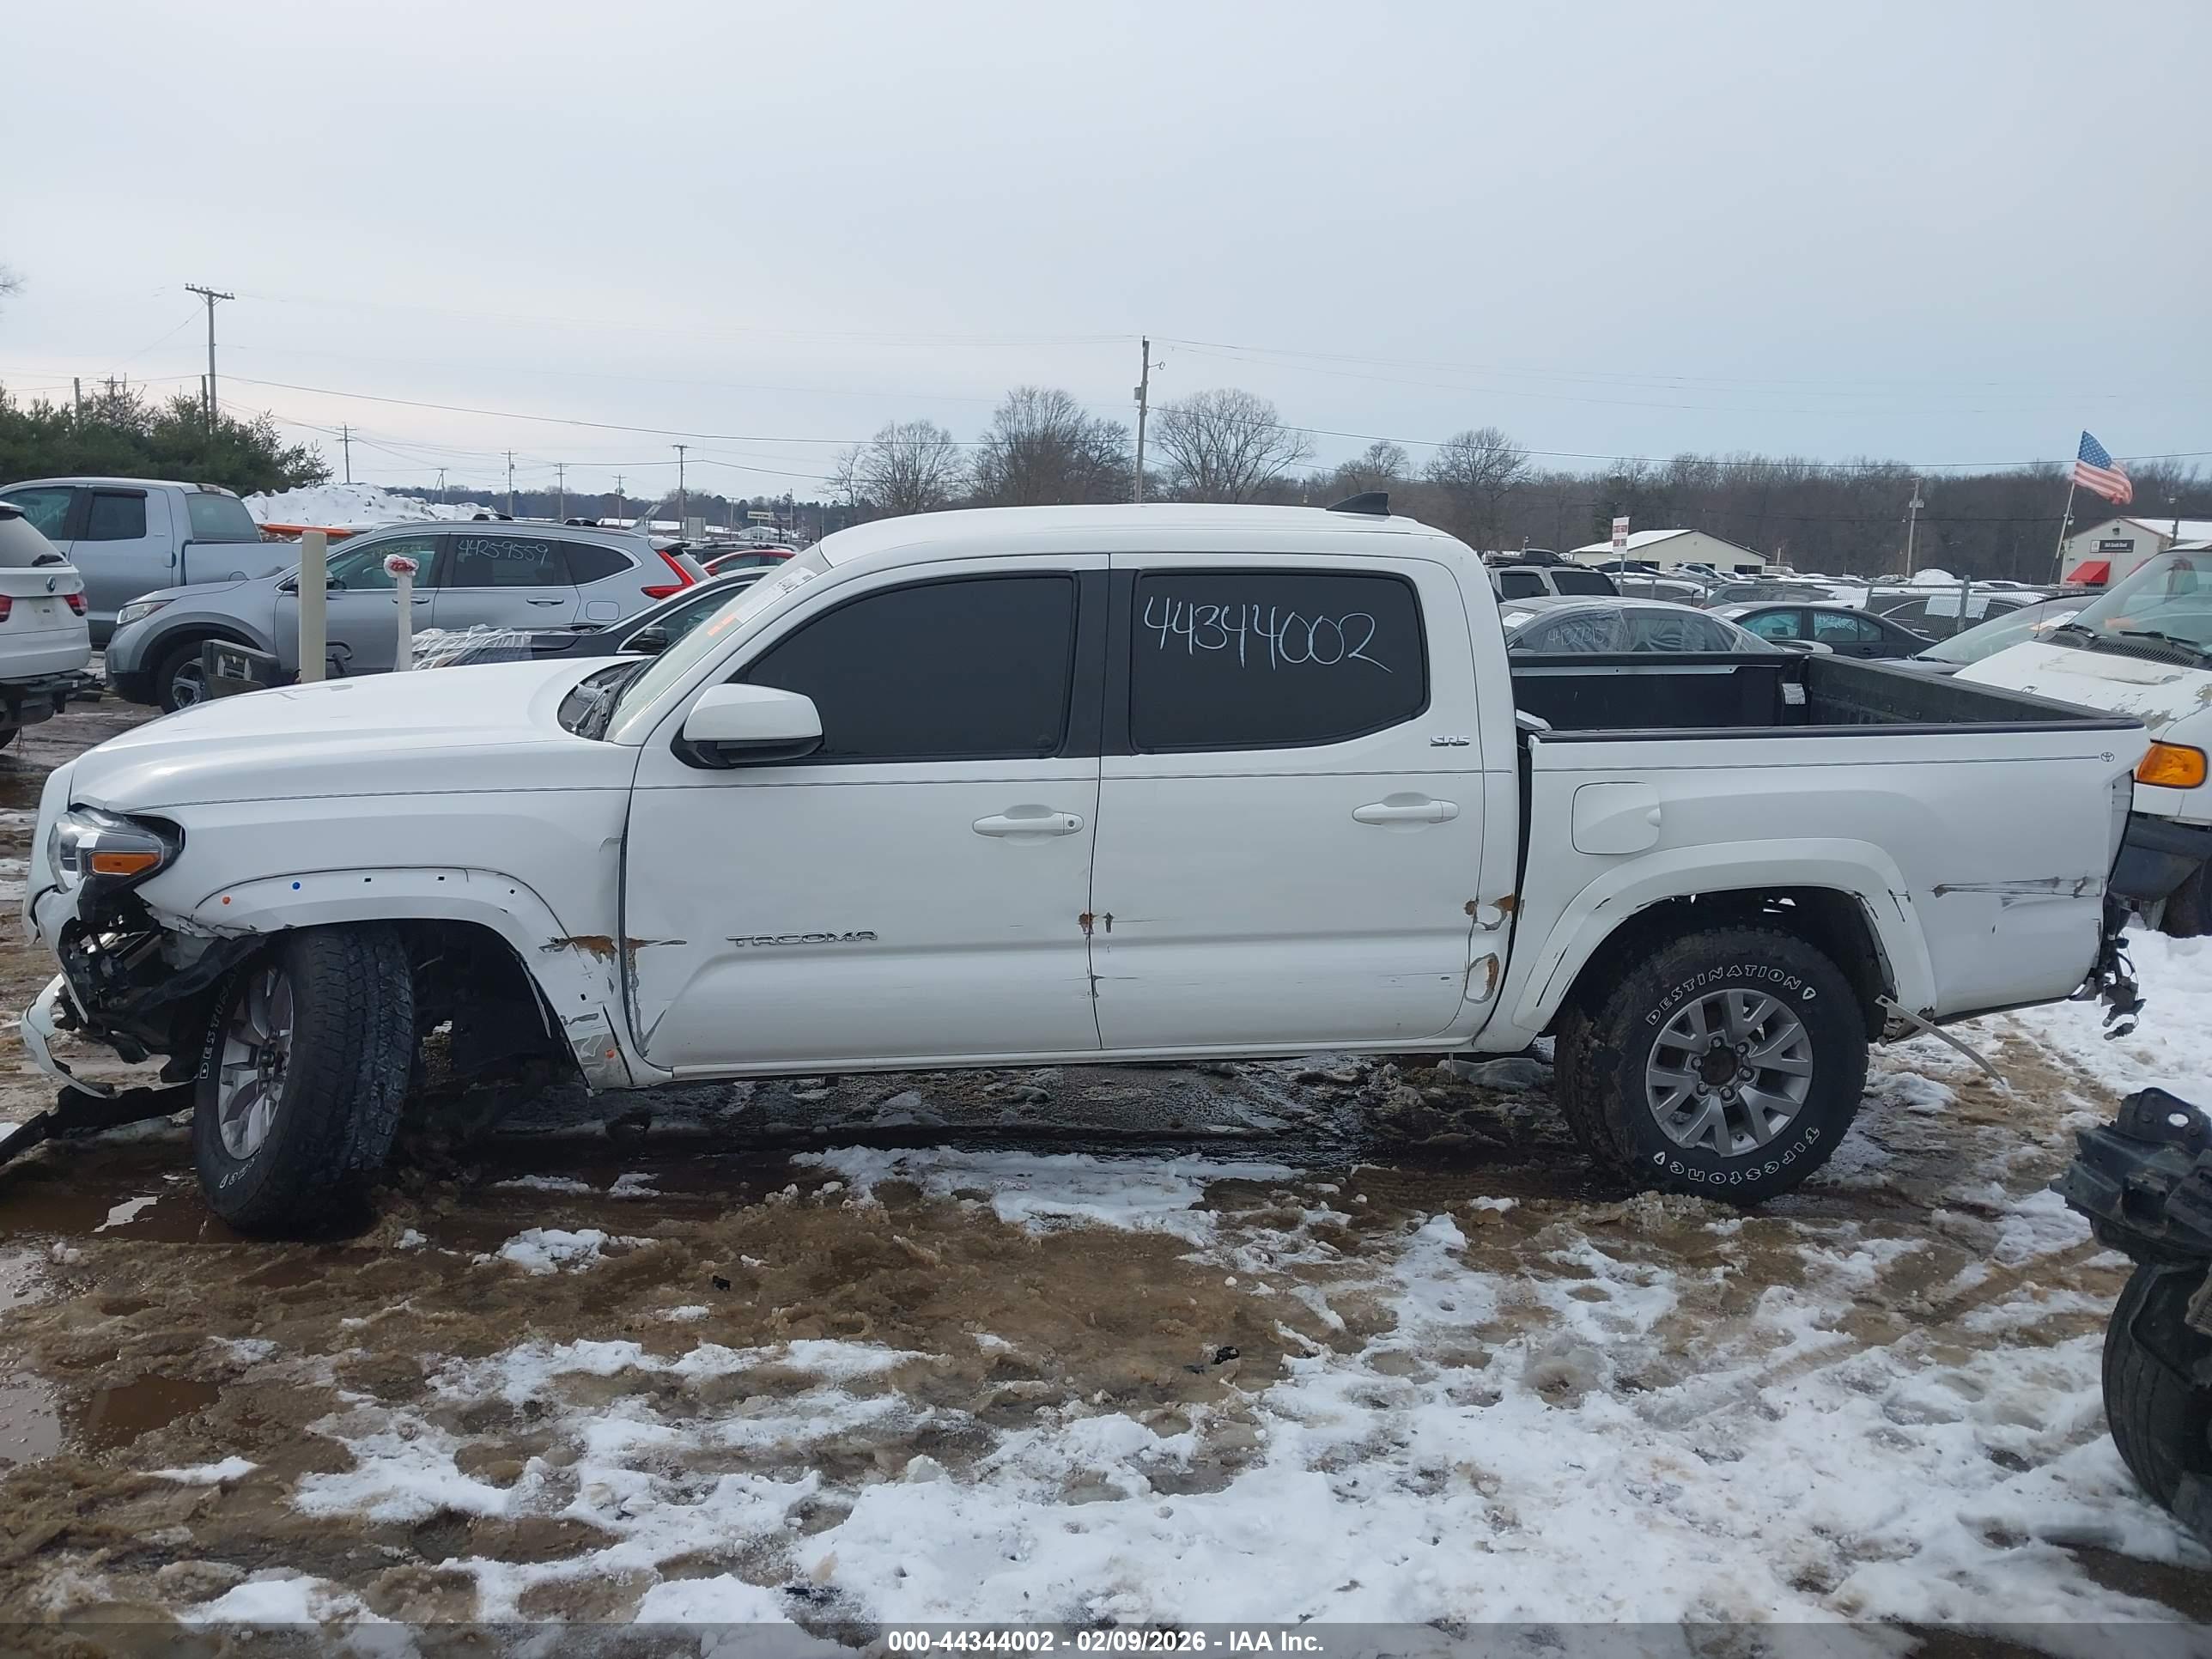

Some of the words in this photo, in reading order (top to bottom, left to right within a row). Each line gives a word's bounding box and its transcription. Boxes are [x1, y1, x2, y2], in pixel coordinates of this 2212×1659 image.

[1144, 596, 1394, 673] 44344002
[726, 927, 878, 947] TACOMA
[1644, 963, 1802, 1026] DESTINATION
